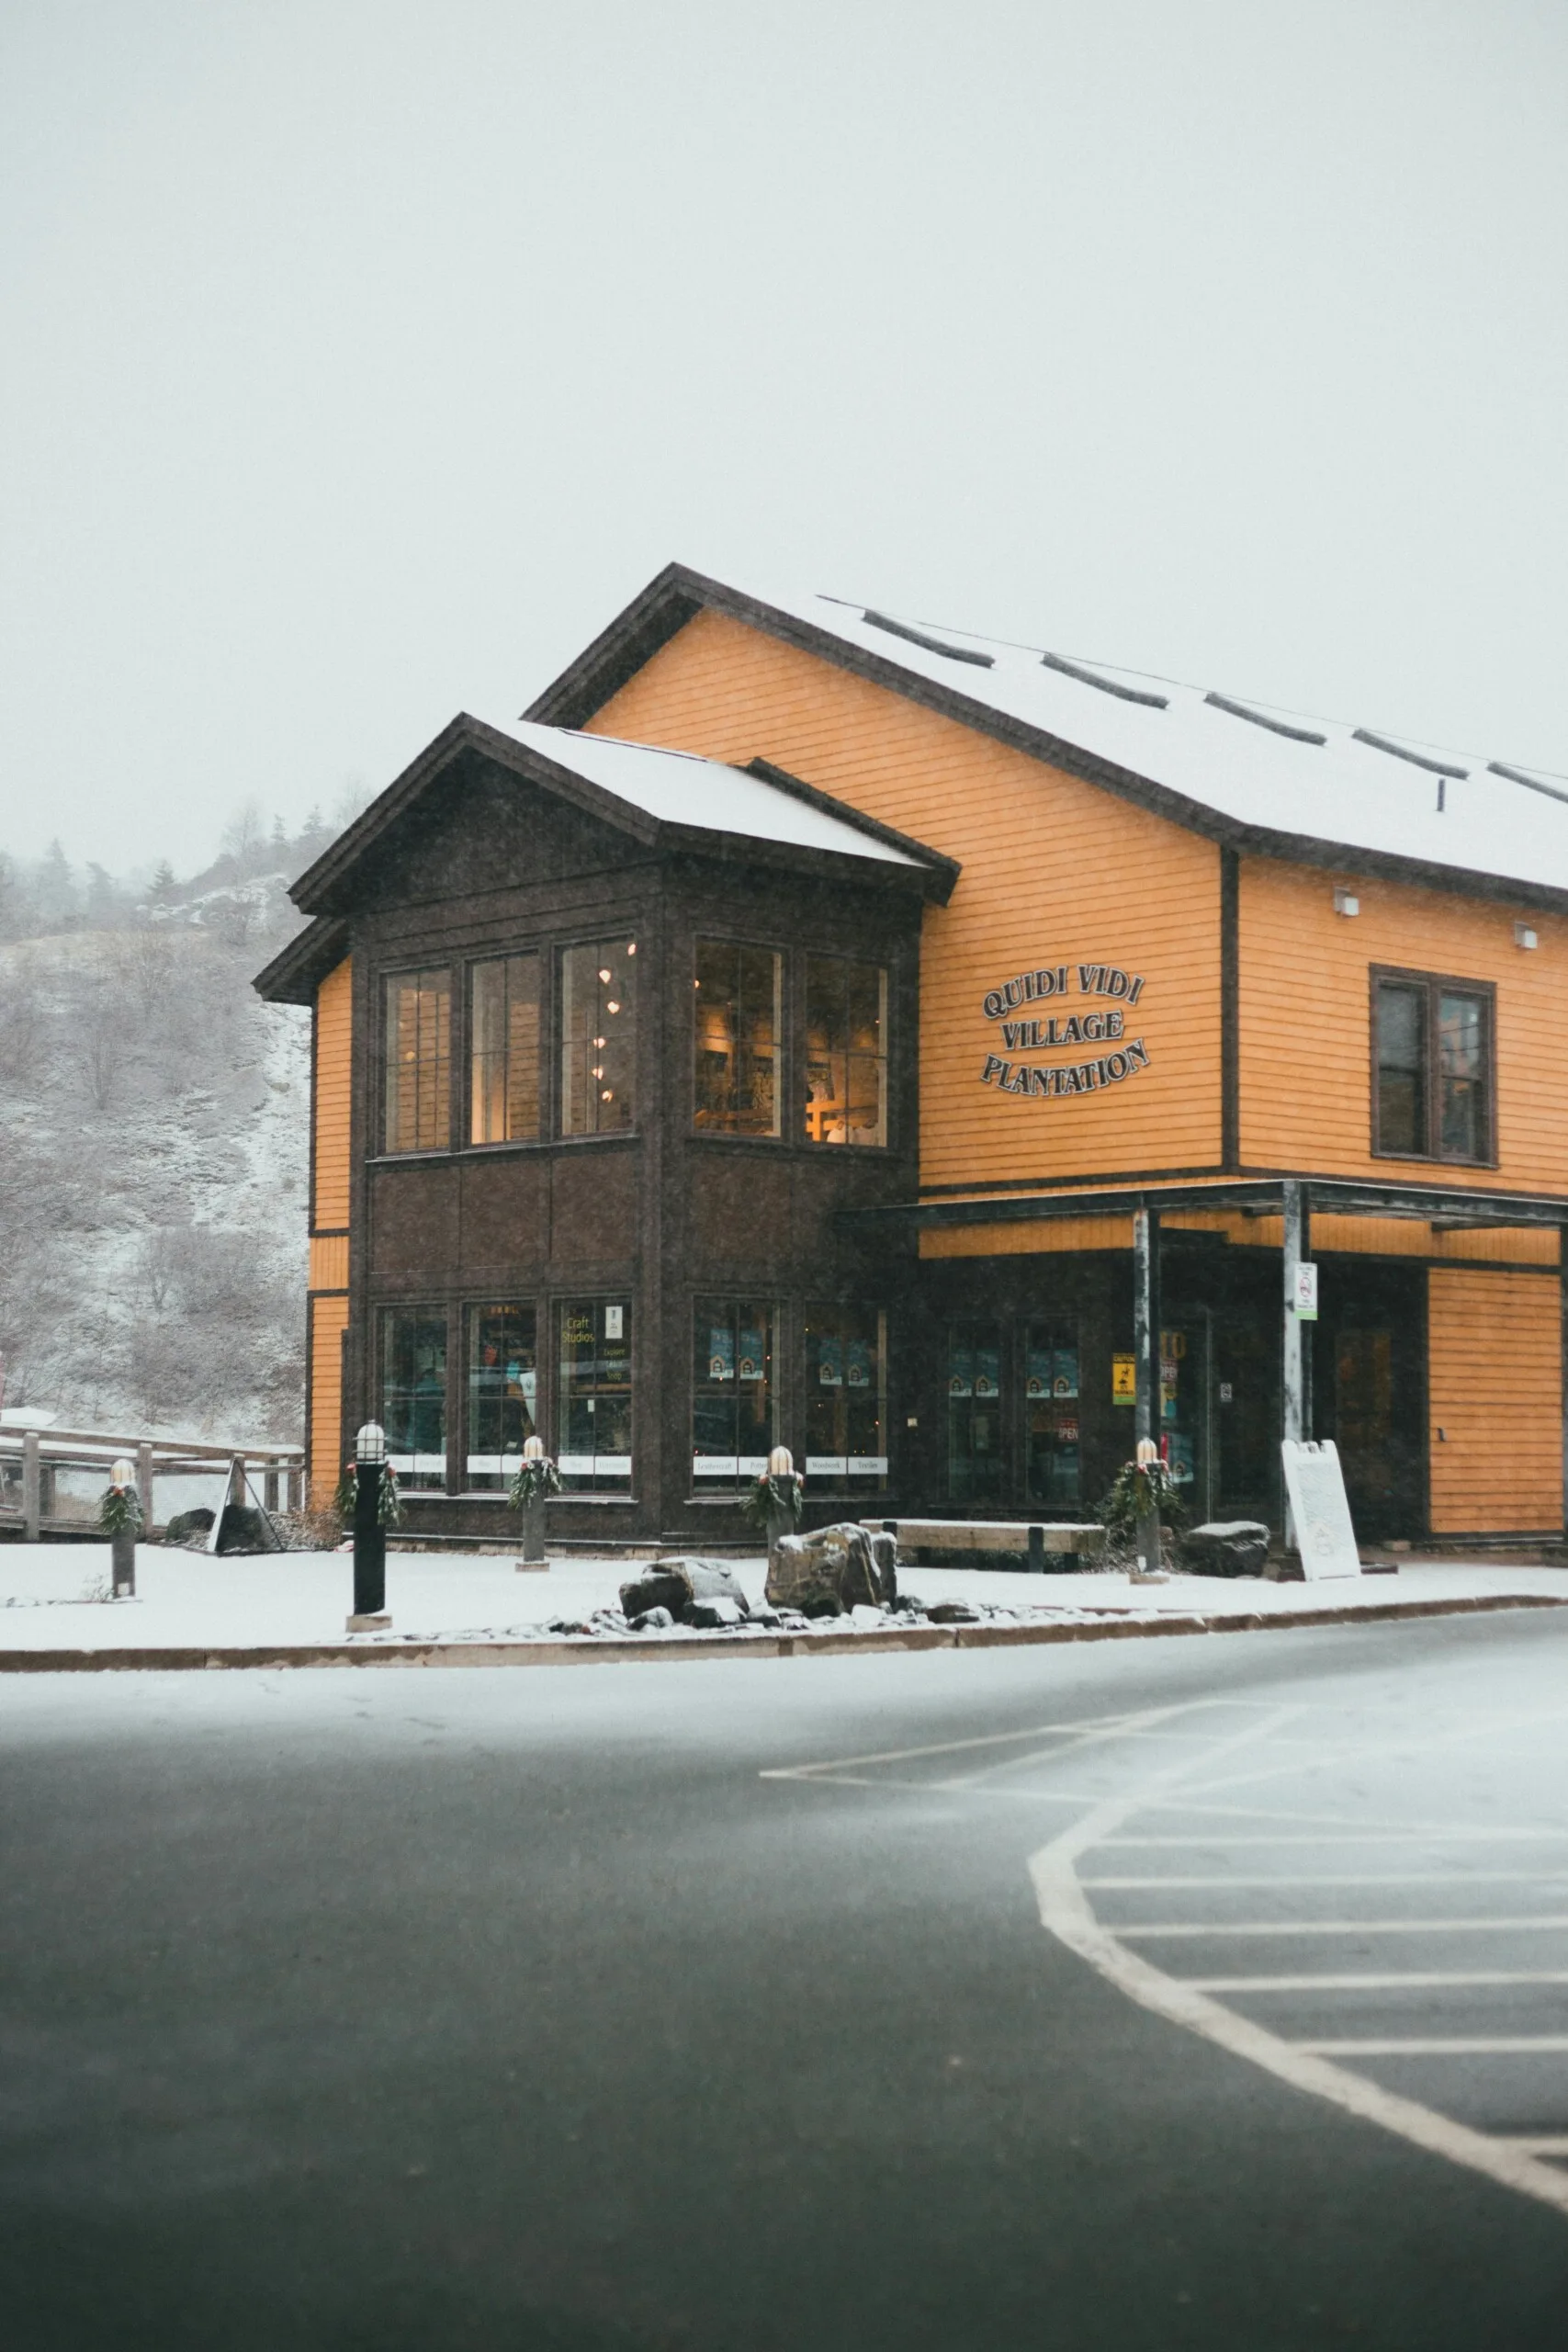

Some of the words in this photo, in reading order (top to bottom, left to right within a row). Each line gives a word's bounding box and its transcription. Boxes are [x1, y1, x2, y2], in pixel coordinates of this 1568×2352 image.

[983, 966, 1068, 1019] QUIDI
[1077, 964, 1145, 1005] VIDI
[1000, 1009, 1124, 1050] VILLAGE
[980, 1037, 1150, 1096] PLANTATION
[562, 1331, 594, 1342] Studios
[567, 1316, 589, 1329] Craft
